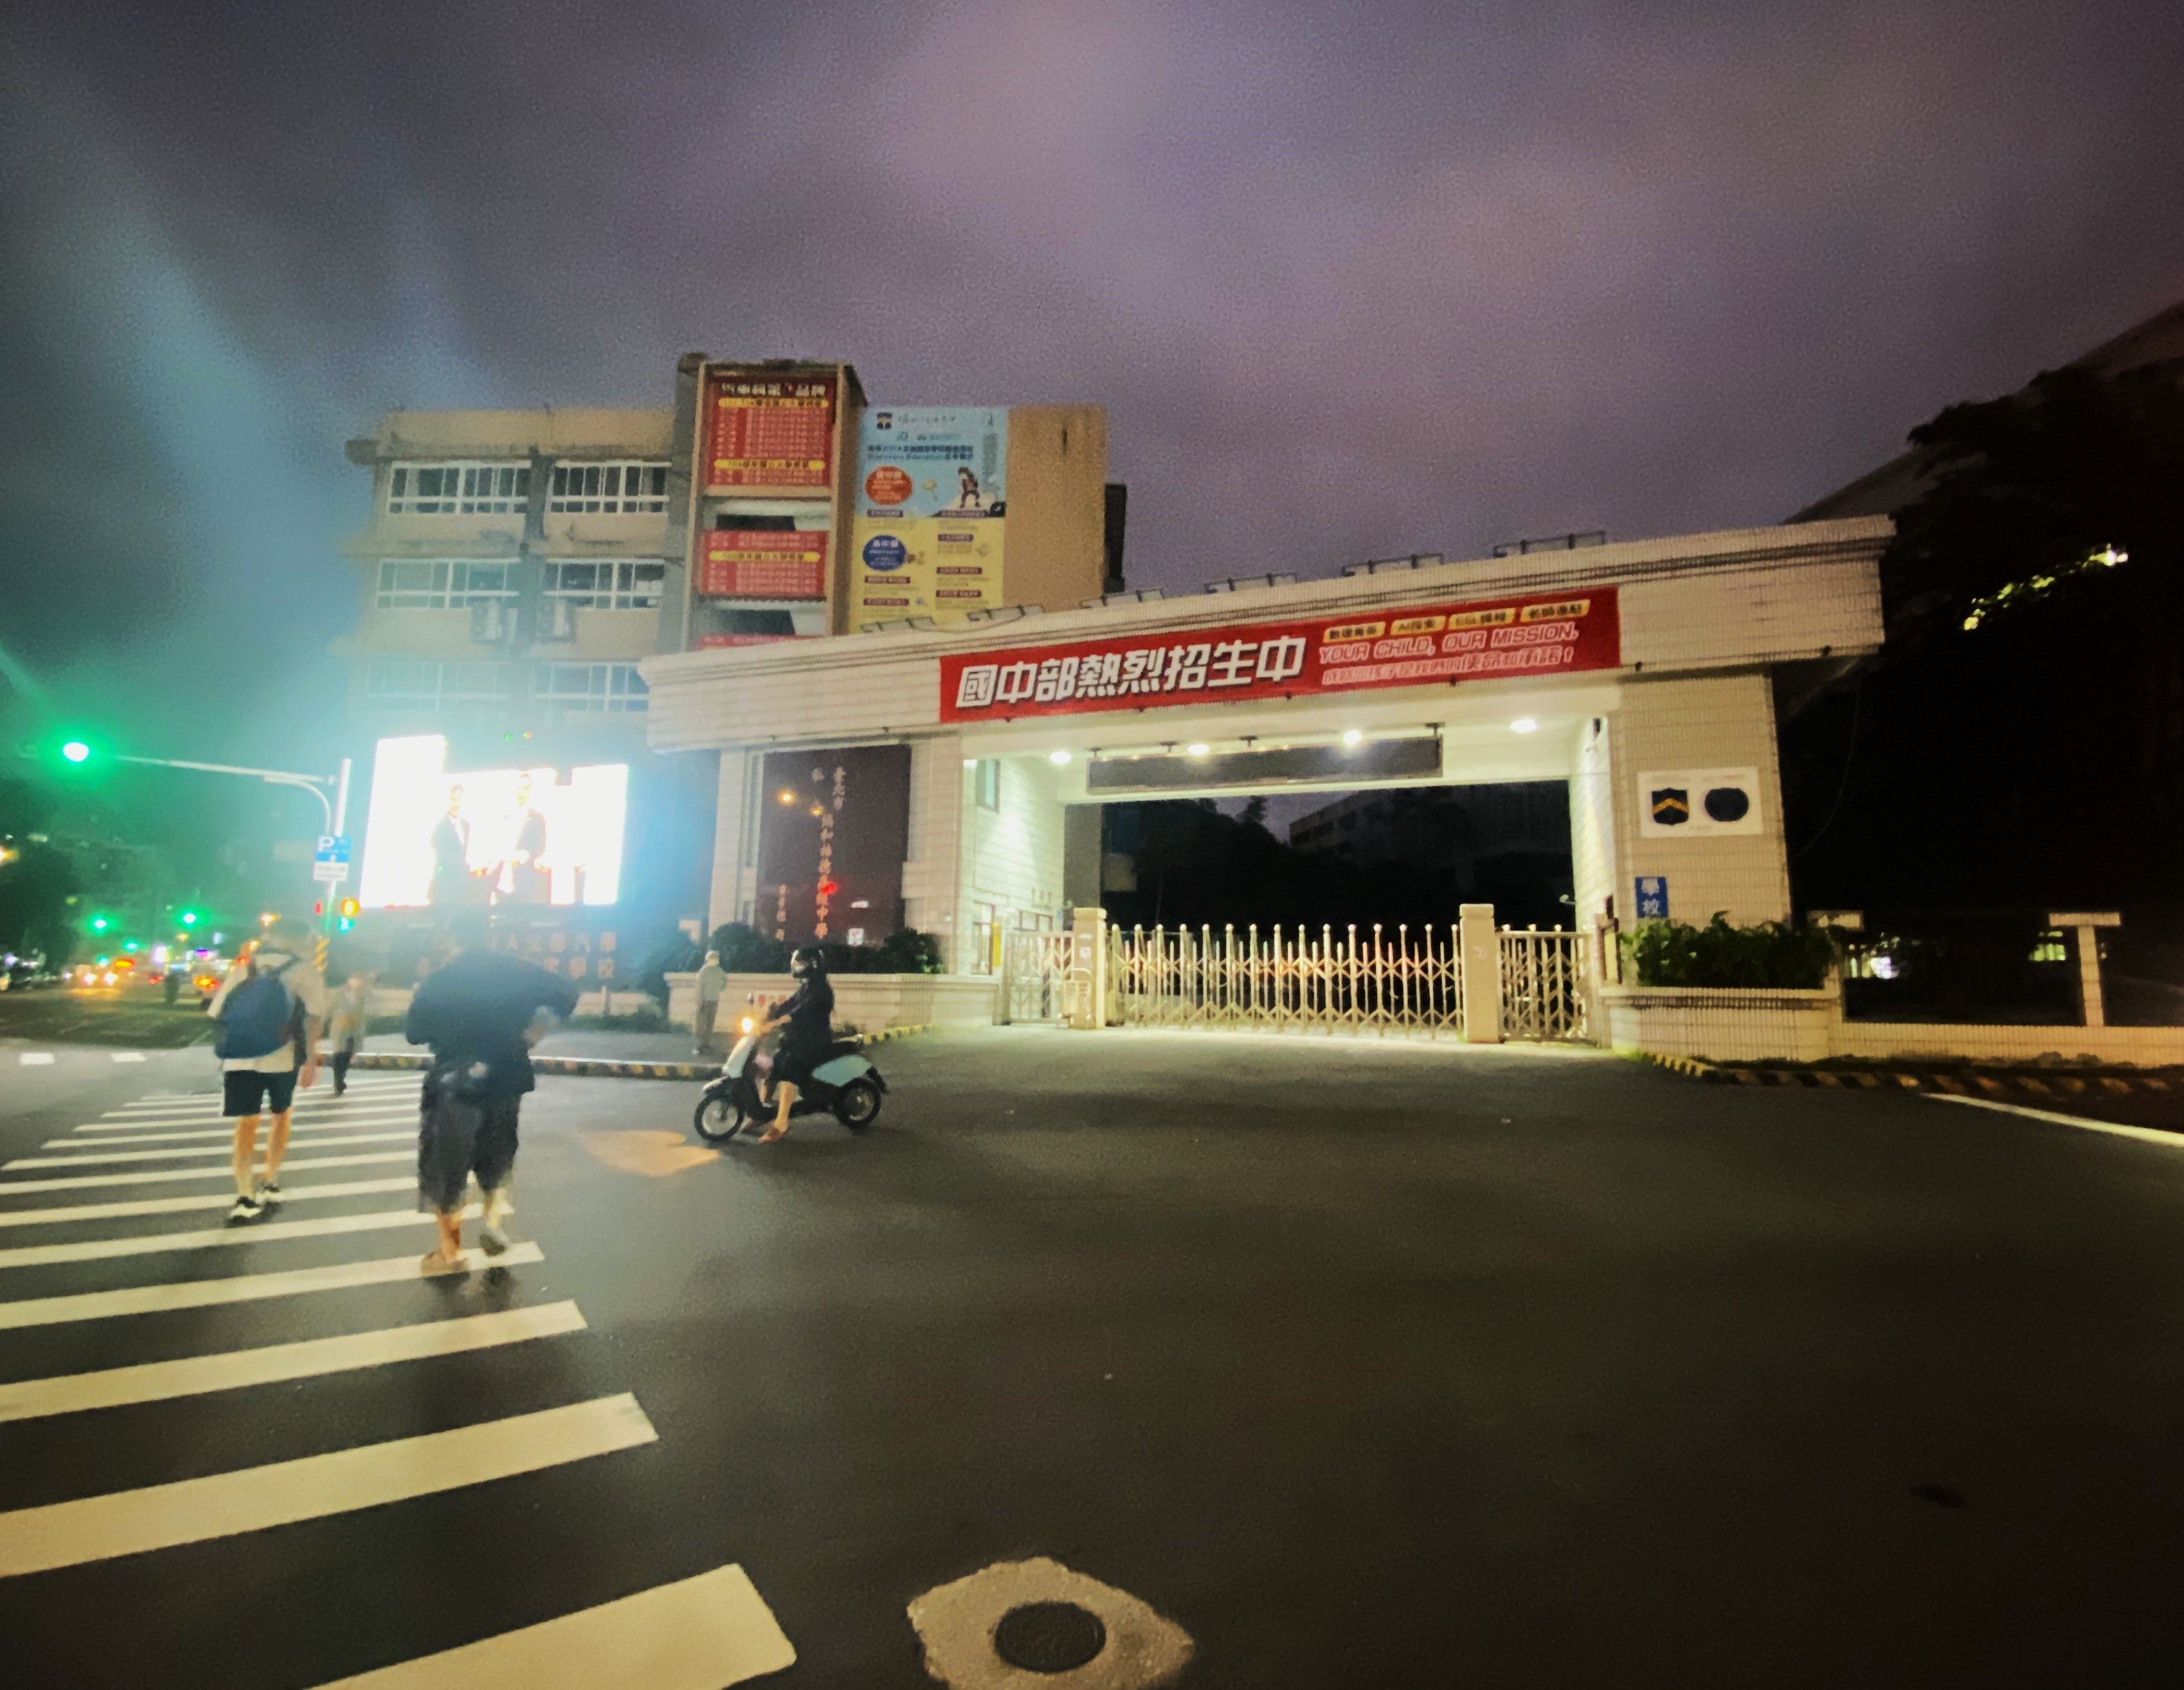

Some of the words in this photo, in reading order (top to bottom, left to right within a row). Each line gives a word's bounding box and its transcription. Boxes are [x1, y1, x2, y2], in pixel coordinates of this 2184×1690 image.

[1320, 643, 1369, 664] YOUR
[1443, 631, 1486, 651] OUR
[955, 636, 1306, 708] 國中部熱烈招生中
[318, 836, 334, 853] P
